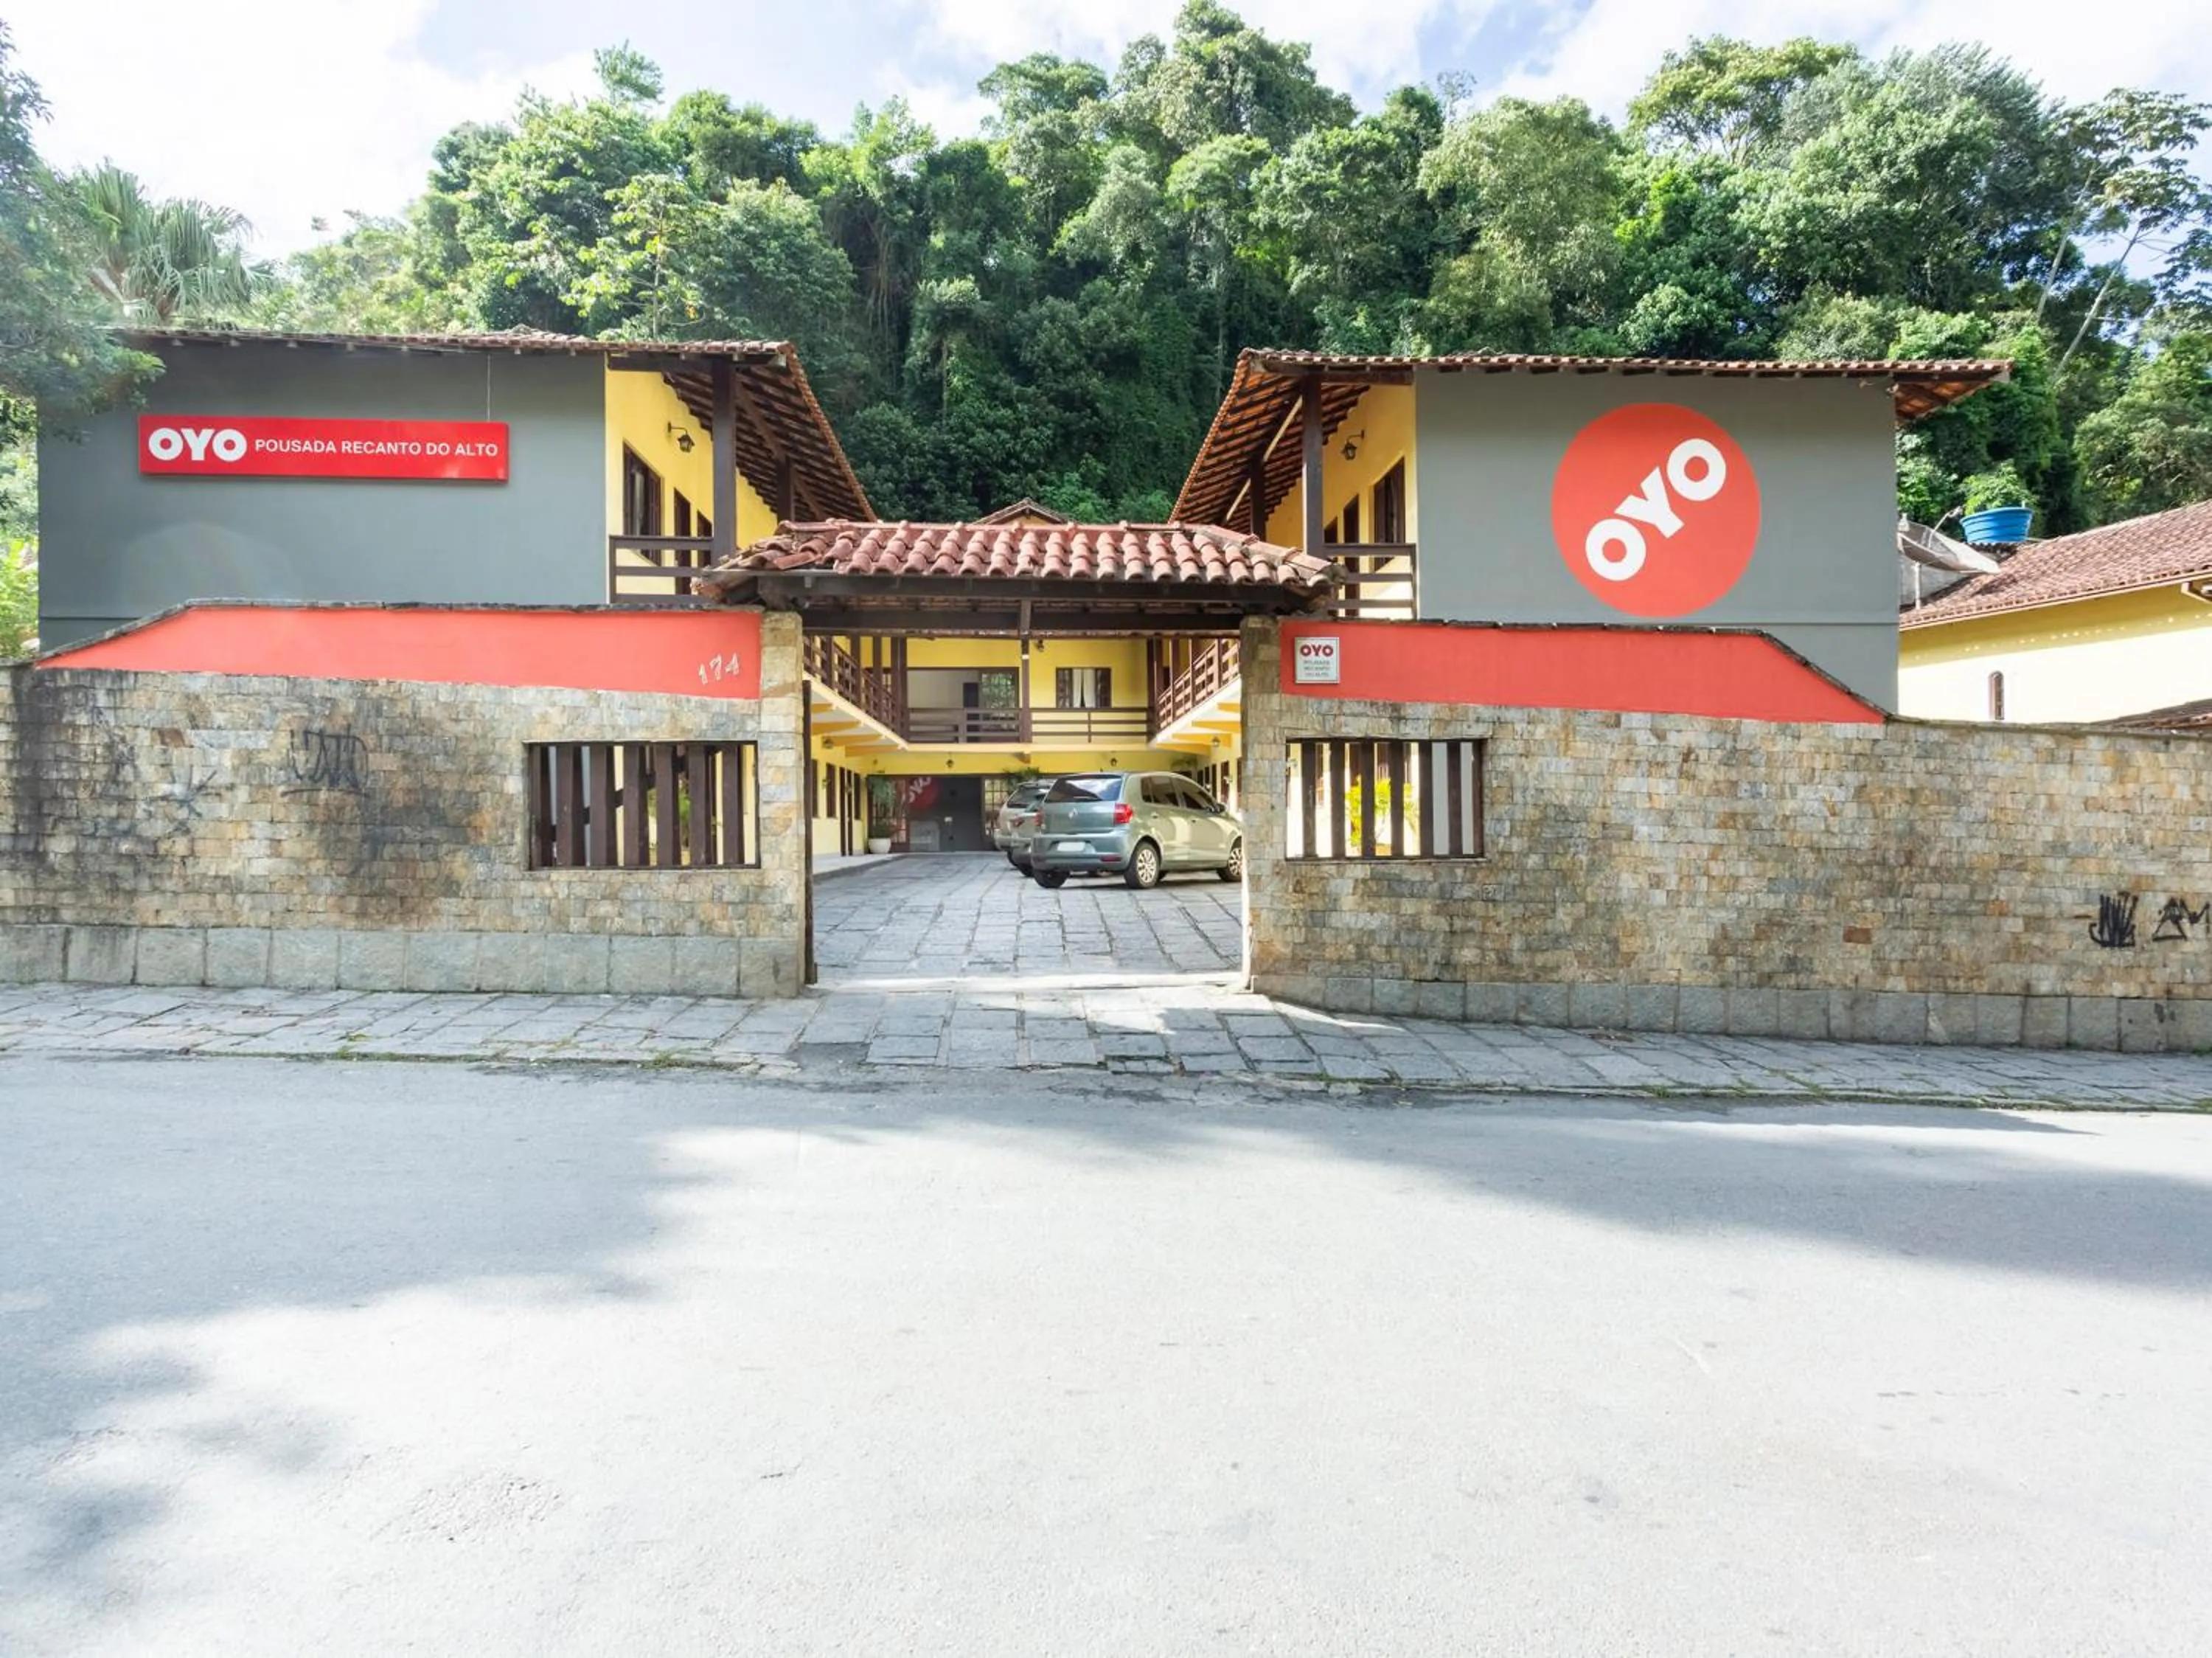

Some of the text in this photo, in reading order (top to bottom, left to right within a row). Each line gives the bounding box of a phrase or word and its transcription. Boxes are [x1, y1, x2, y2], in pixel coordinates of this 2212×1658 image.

[148, 427, 498, 462] OYO POUSADA RECANTO DO ALTO
[1585, 438, 1727, 581] OYO
[1300, 644, 1334, 657] OYO
[698, 653, 740, 686] 174
